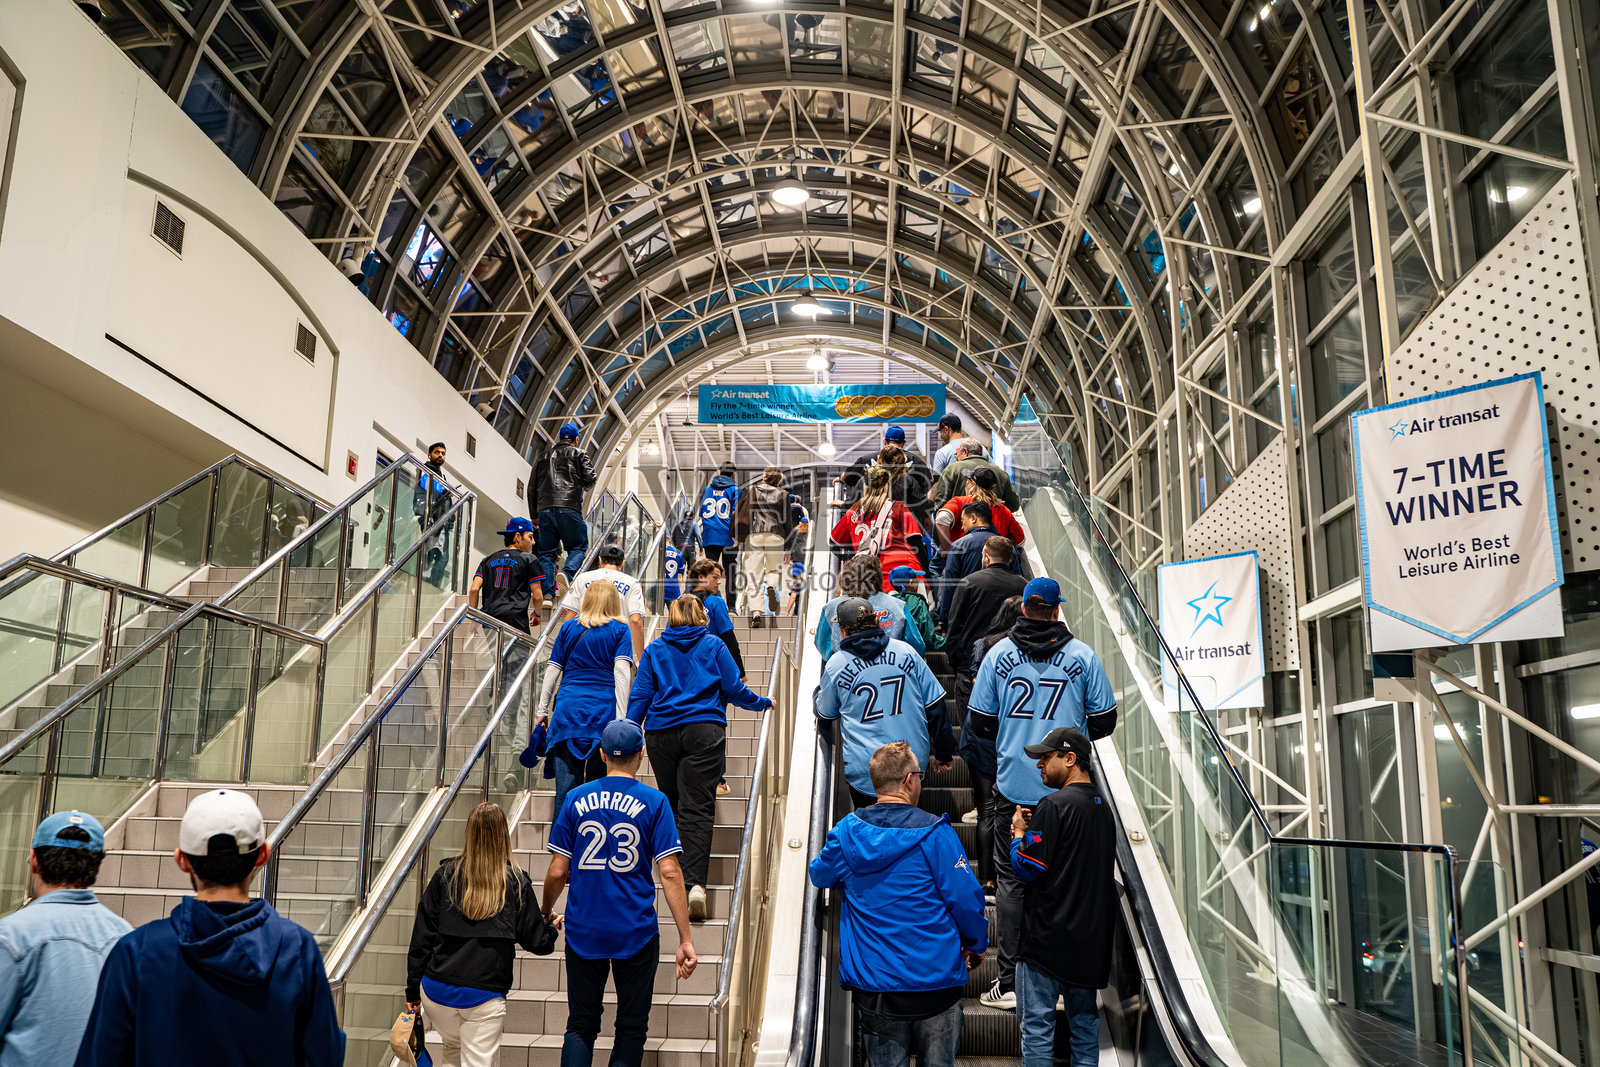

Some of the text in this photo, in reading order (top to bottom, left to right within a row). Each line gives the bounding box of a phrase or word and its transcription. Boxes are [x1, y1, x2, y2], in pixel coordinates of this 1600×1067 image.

[710, 402, 722, 410] Fly
[722, 390, 770, 399] Air transat
[710, 412, 740, 420] World's
[792, 412, 817, 420] Airline
[1409, 404, 1500, 435] Air transat
[1393, 448, 1508, 495] 7-TIME
[702, 497, 731, 520] 30
[1385, 479, 1523, 526] WINNER
[1403, 533, 1511, 561] World's Best
[665, 559, 679, 579] 9
[1398, 552, 1521, 579] Leisure Airline
[995, 648, 1066, 680] GUERO
[1174, 641, 1252, 662] Air transat
[852, 674, 906, 724] 27
[1007, 676, 1069, 721] 27
[574, 791, 647, 819] MORROW
[577, 820, 641, 873] 23
